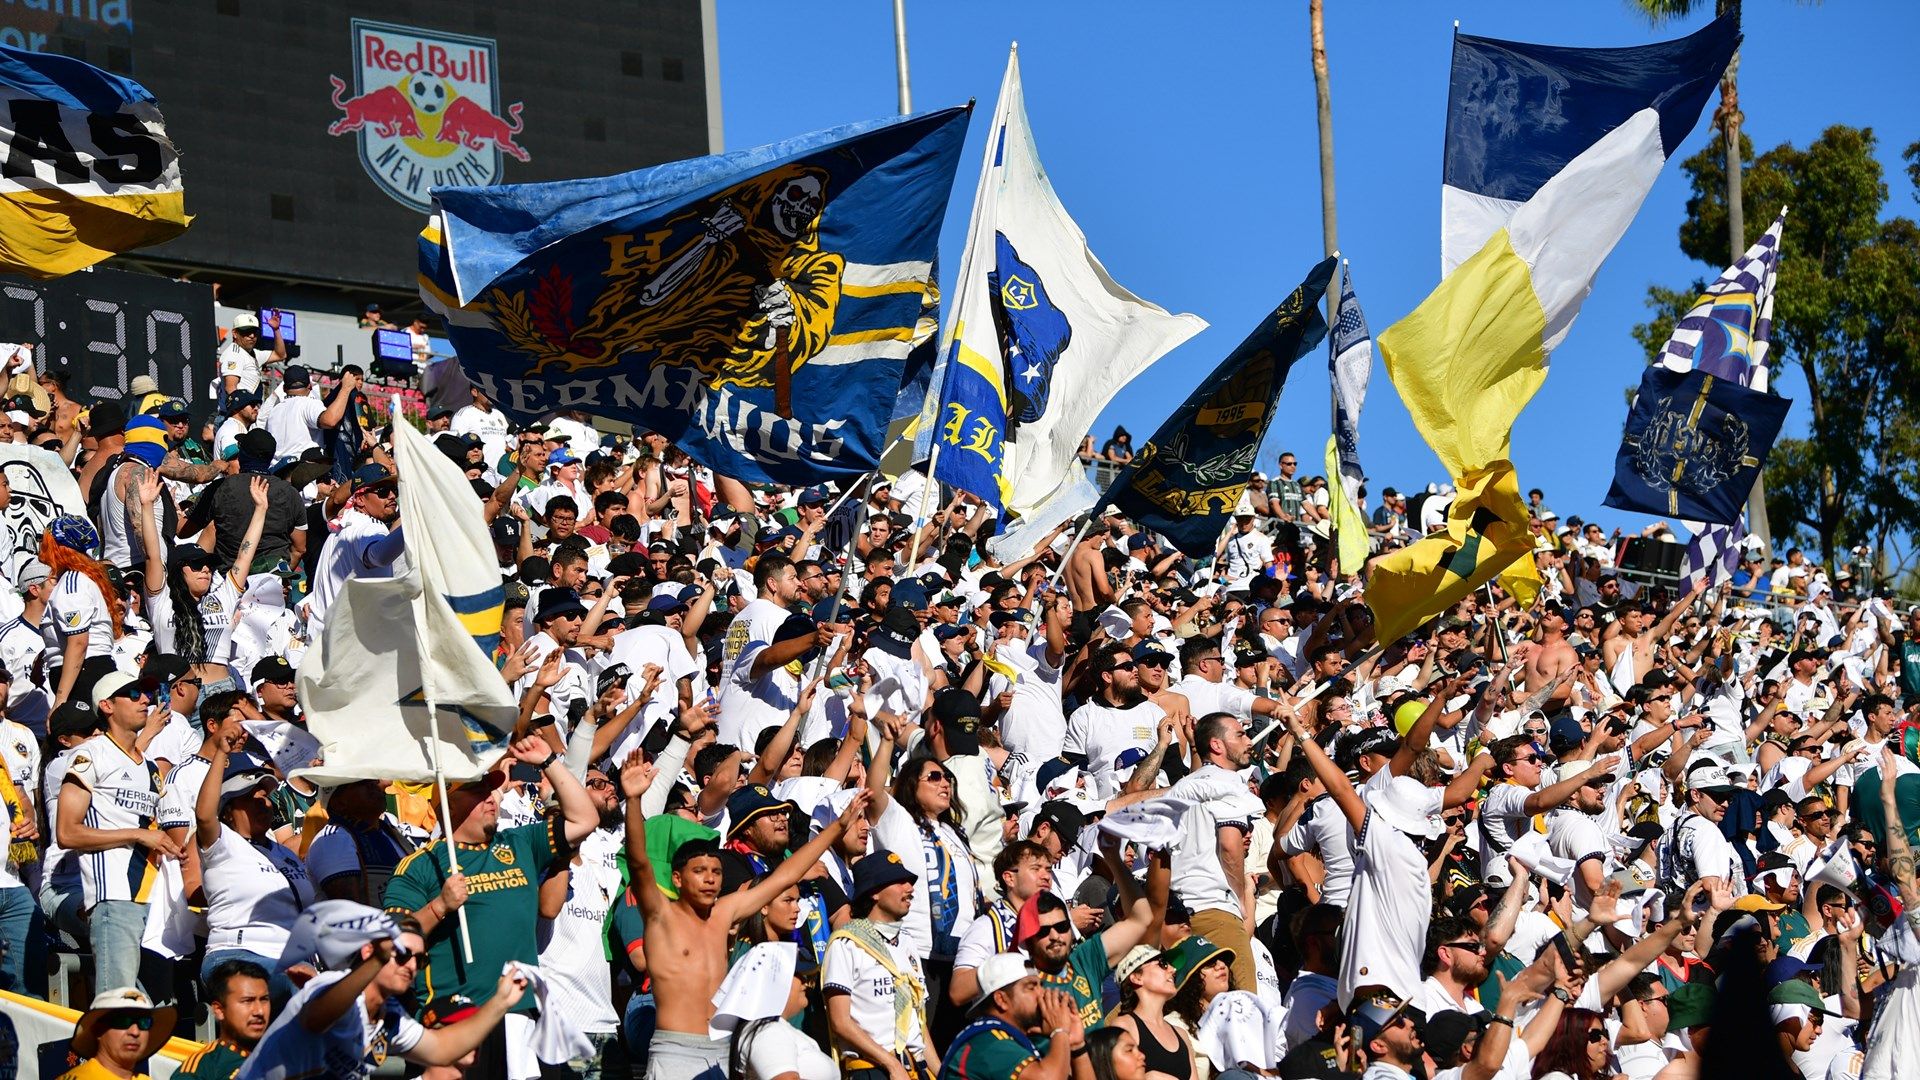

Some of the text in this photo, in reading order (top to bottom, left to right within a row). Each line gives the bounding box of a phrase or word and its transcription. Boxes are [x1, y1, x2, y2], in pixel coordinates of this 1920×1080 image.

[365, 35, 487, 84] Red Bull
[376, 143, 423, 195] NEW
[505, 523, 515, 536] LA
[567, 905, 607, 923] Herbalif
